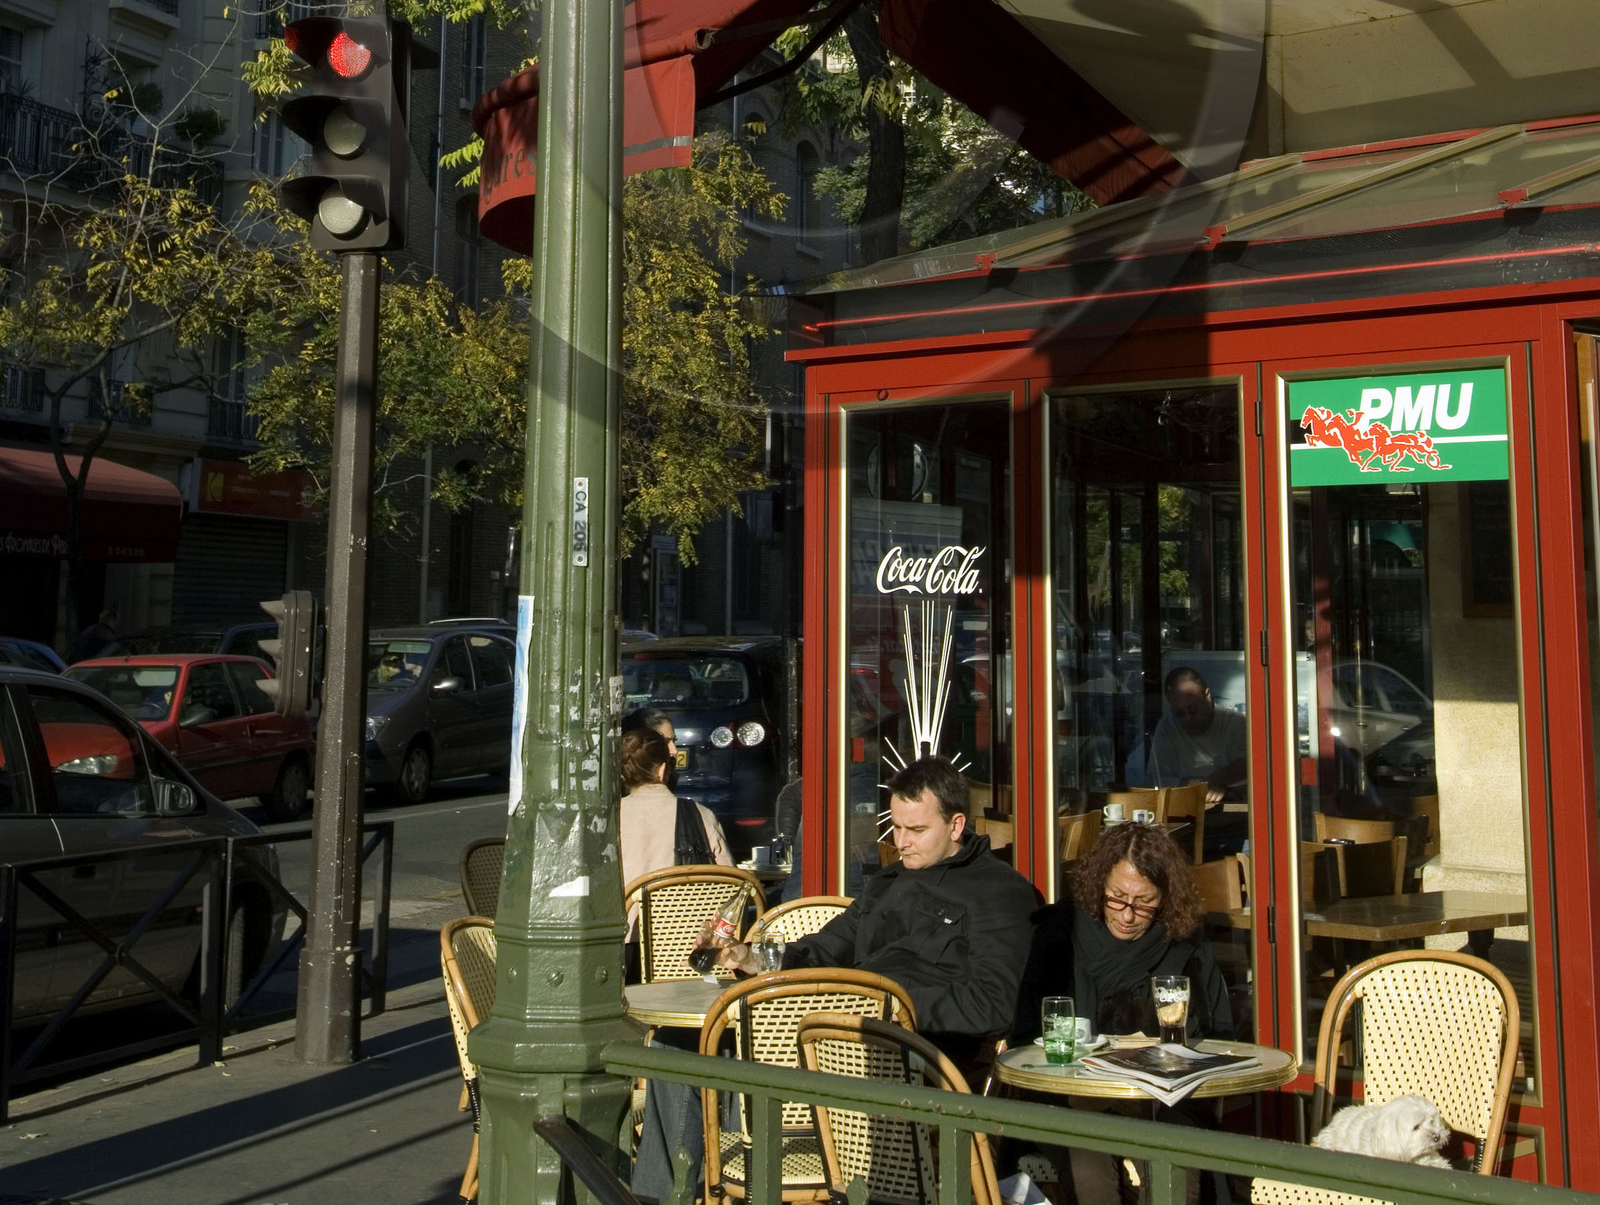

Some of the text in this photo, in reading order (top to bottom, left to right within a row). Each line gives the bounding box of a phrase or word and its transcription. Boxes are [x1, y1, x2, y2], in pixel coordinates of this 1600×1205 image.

[1359, 382, 1474, 432] PMU
[574, 490, 587, 513] CA
[875, 545, 987, 594] Coca-Cola
